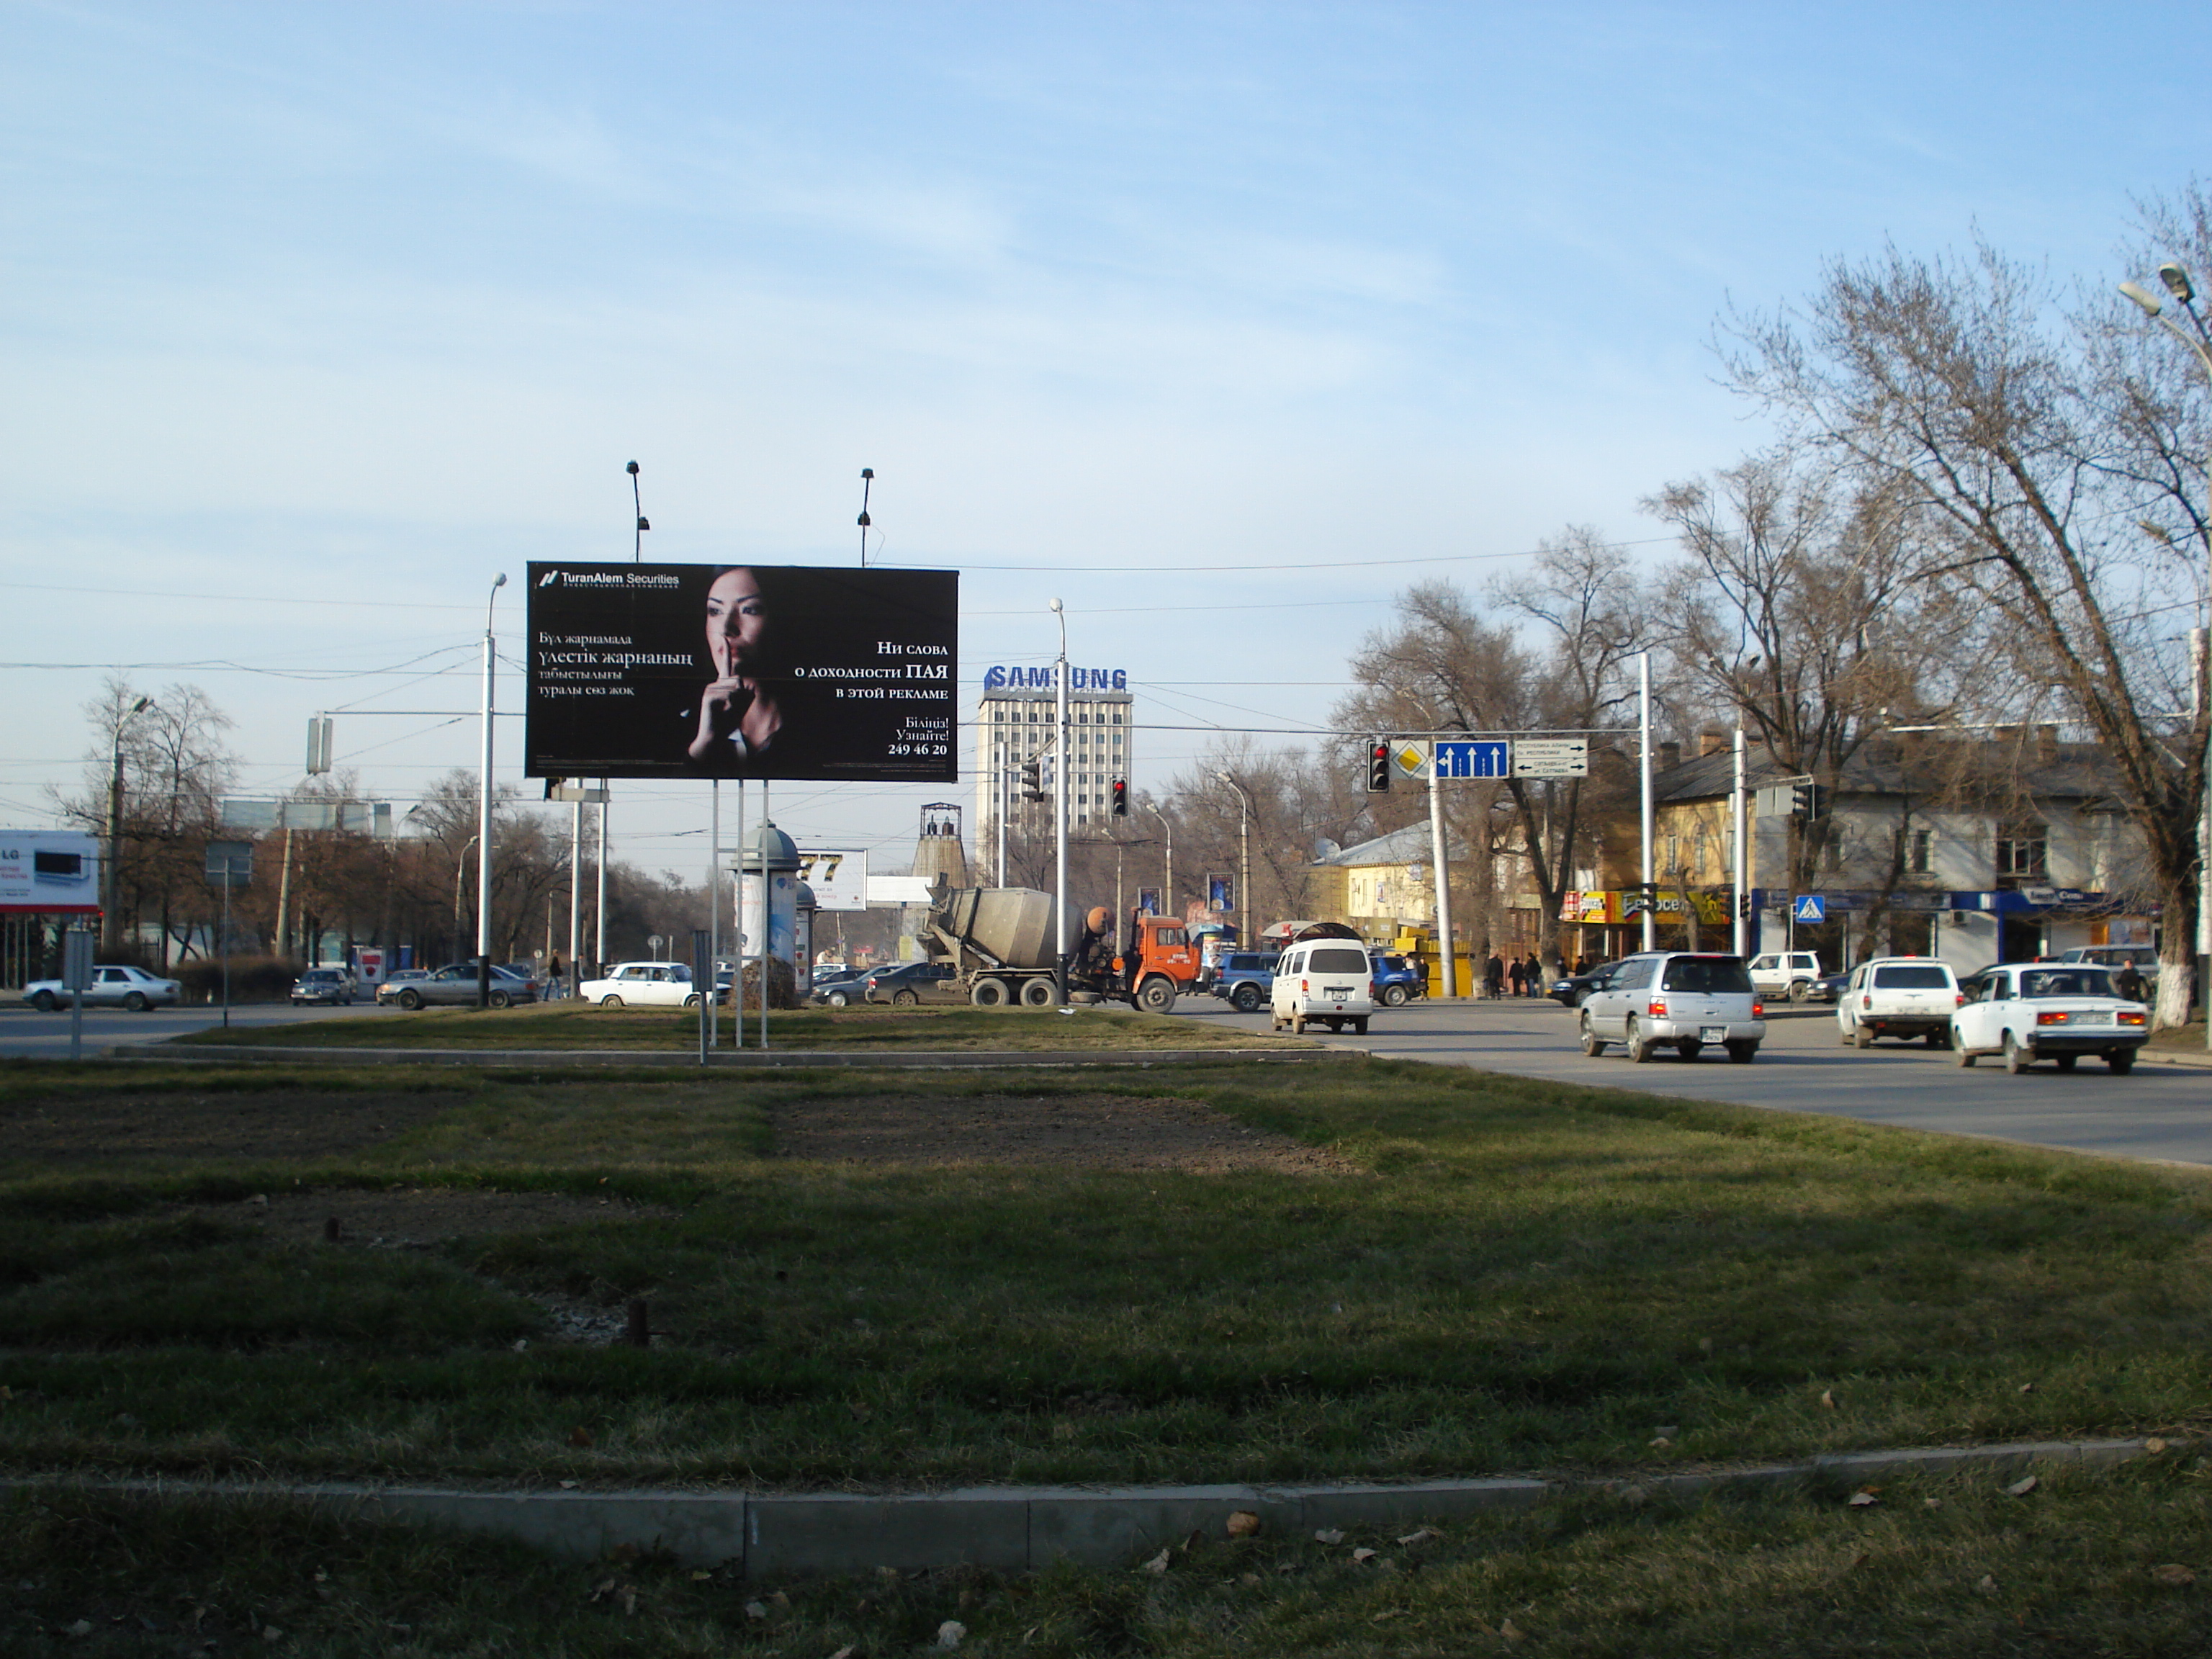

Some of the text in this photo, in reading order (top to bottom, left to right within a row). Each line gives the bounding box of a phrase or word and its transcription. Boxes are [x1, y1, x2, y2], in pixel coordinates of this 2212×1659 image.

[562, 572, 679, 584] TuranAlem Securities
[565, 635, 631, 647] жарнамада
[905, 664, 948, 679] ПАЯ
[989, 665, 1127, 689] SAMUNG
[538, 685, 582, 698] туралы
[896, 729, 949, 742] Узнайте!
[888, 743, 948, 755] 249 46 20
[2, 850, 19, 860] LG
